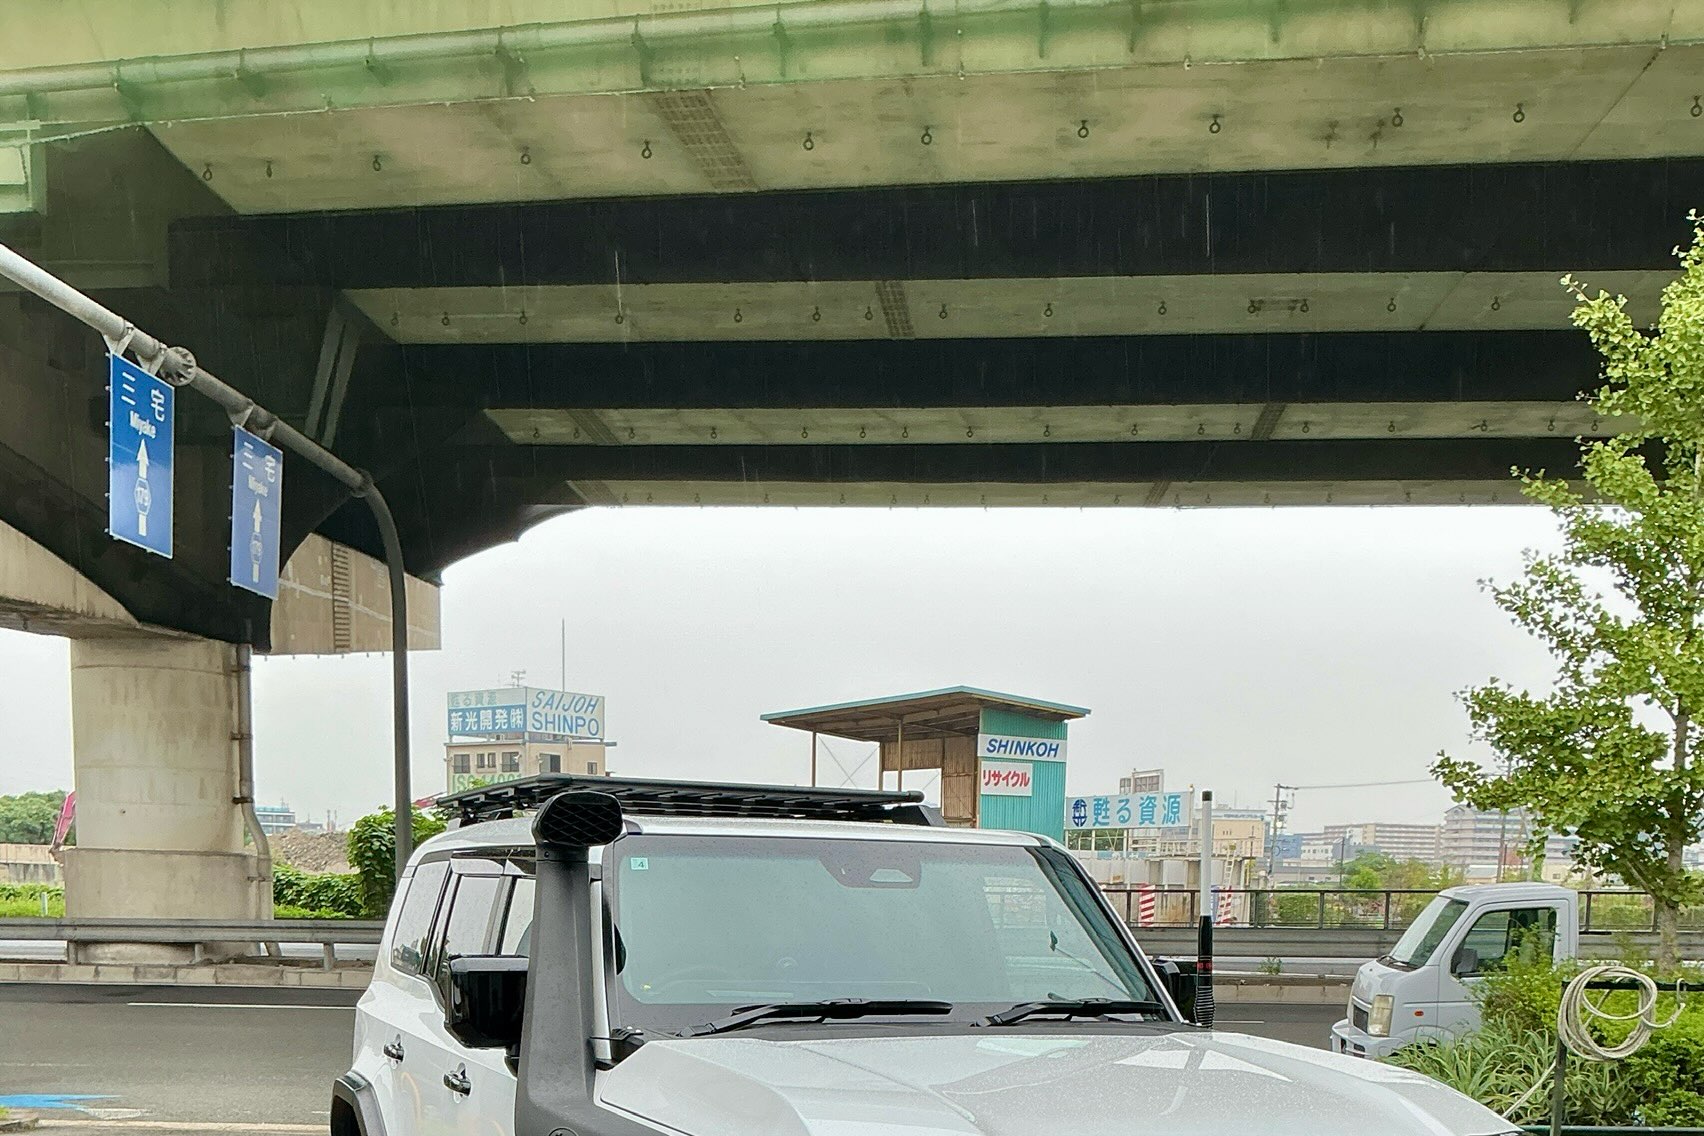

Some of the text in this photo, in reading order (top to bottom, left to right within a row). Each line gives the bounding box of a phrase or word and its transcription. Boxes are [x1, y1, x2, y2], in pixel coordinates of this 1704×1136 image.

[121, 371, 165, 422] 三宅
[129, 410, 157, 439] Miyake
[242, 441, 276, 483] 三宅
[532, 690, 600, 715] SAIJOH
[531, 711, 600, 737] SHINPO
[986, 738, 1060, 758] SHINKOH
[983, 769, 1031, 788] リサイクル
[1092, 795, 1181, 827] 甦る資源
